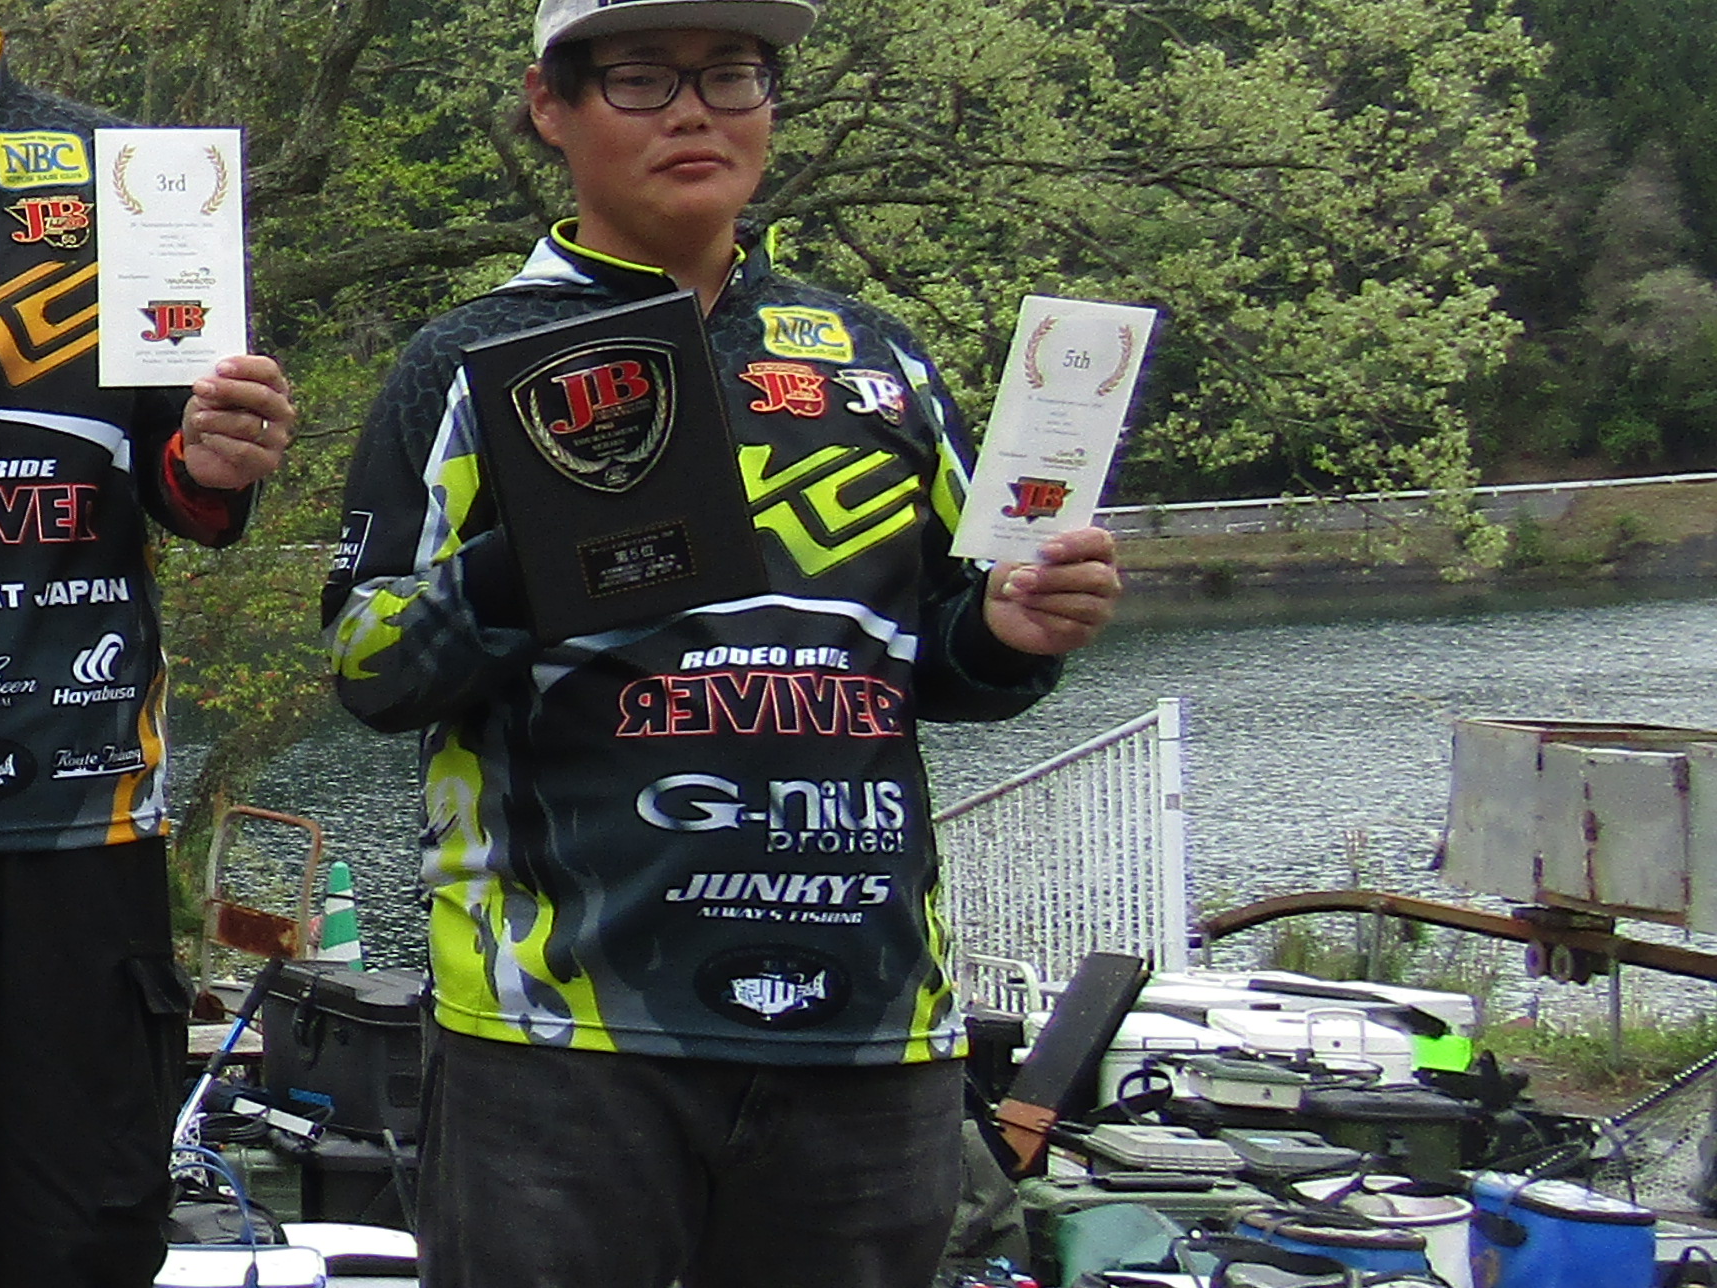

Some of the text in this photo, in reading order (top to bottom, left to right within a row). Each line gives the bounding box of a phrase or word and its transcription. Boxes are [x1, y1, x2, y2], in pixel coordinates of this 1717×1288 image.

[1, 142, 80, 173] NBC
[155, 173, 186, 192] 3rd
[141, 304, 206, 342] JB
[775, 316, 845, 348] NBC
[1062, 349, 1091, 370] 5th
[550, 361, 650, 434] JB
[1001, 482, 1066, 520] JB
[33, 576, 131, 608] JAPAN
[679, 646, 851, 670] RODEO RIDE
[51, 686, 136, 707] Hayabusa
[615, 671, 906, 738] REVIVER
[634, 772, 906, 832] G-nius
[665, 873, 892, 906] JUNKY'S
